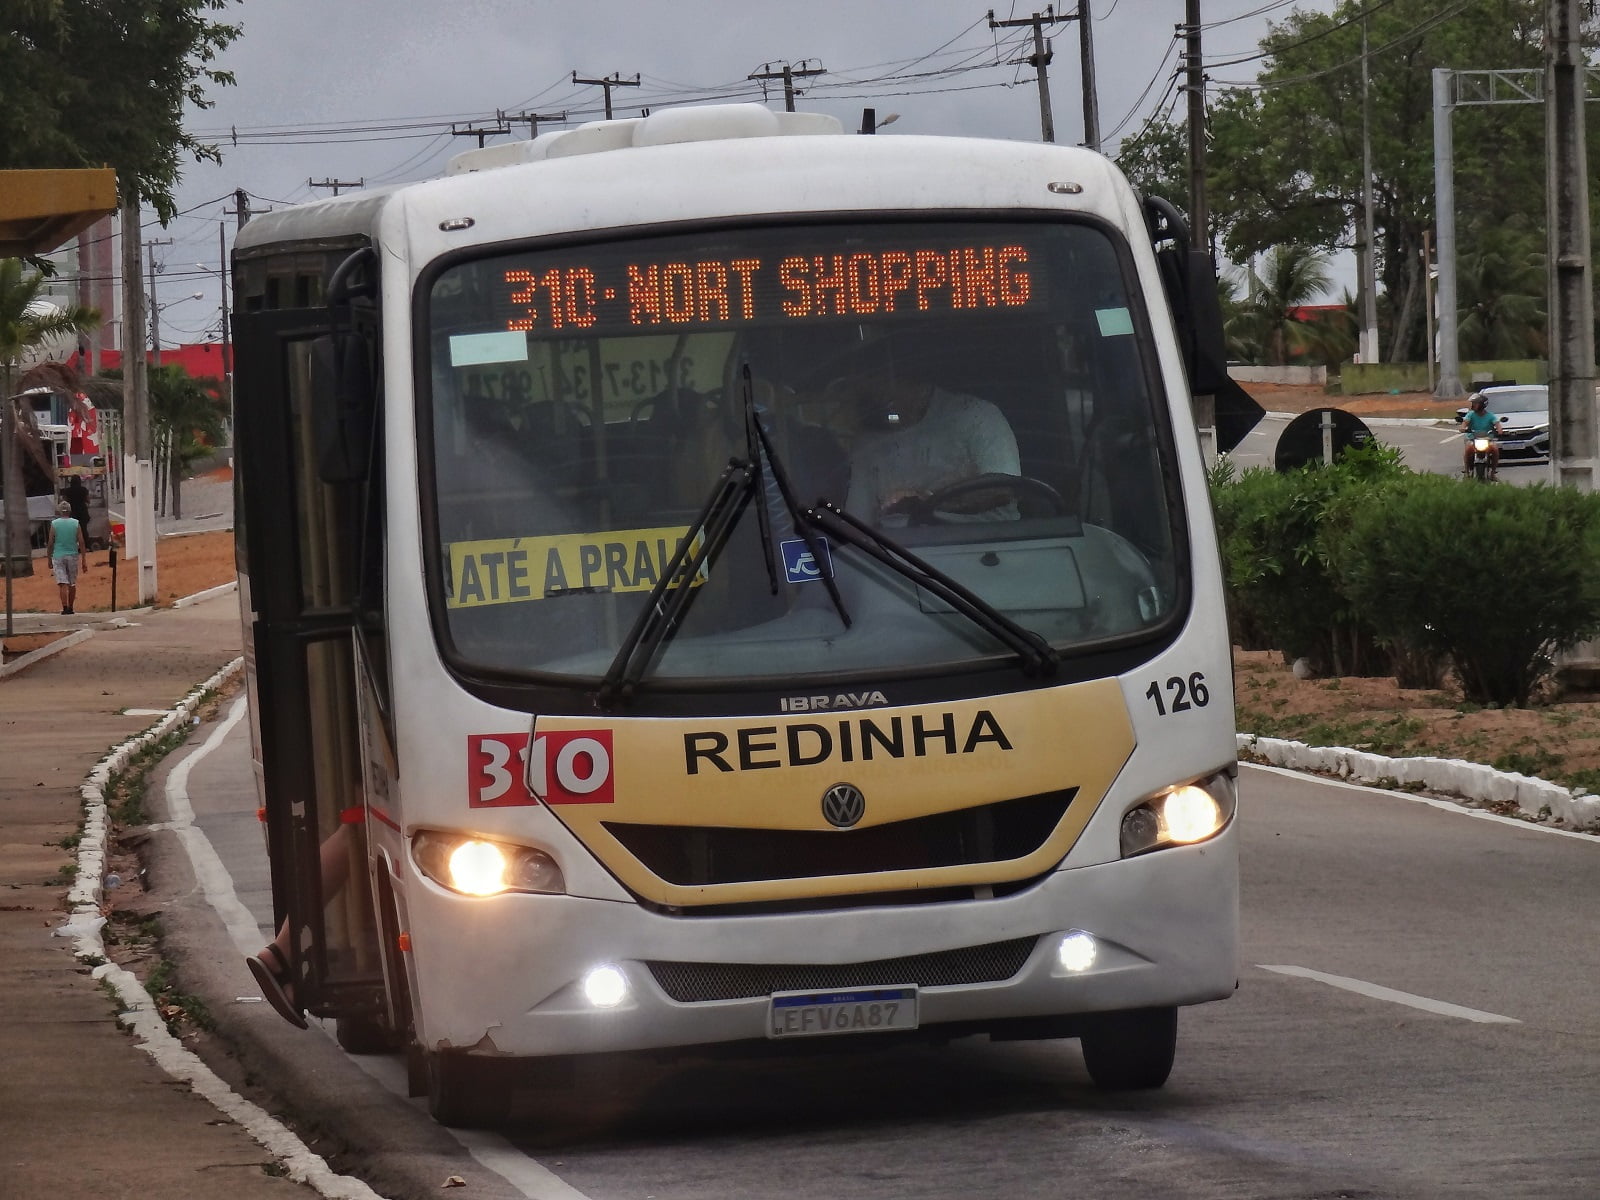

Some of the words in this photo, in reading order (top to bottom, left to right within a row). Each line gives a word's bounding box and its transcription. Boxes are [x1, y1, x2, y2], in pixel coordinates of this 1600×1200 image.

[628, 259, 760, 325] NORT
[780, 246, 1030, 317] SHOPPING
[459, 538, 531, 604] ATÉ
[544, 546, 569, 594] A
[781, 690, 888, 712] IBRAVA
[1145, 671, 1210, 716] 126
[480, 737, 610, 801] 310
[683, 710, 1014, 775] REDINHA
[784, 1003, 899, 1033] EFV6A87
